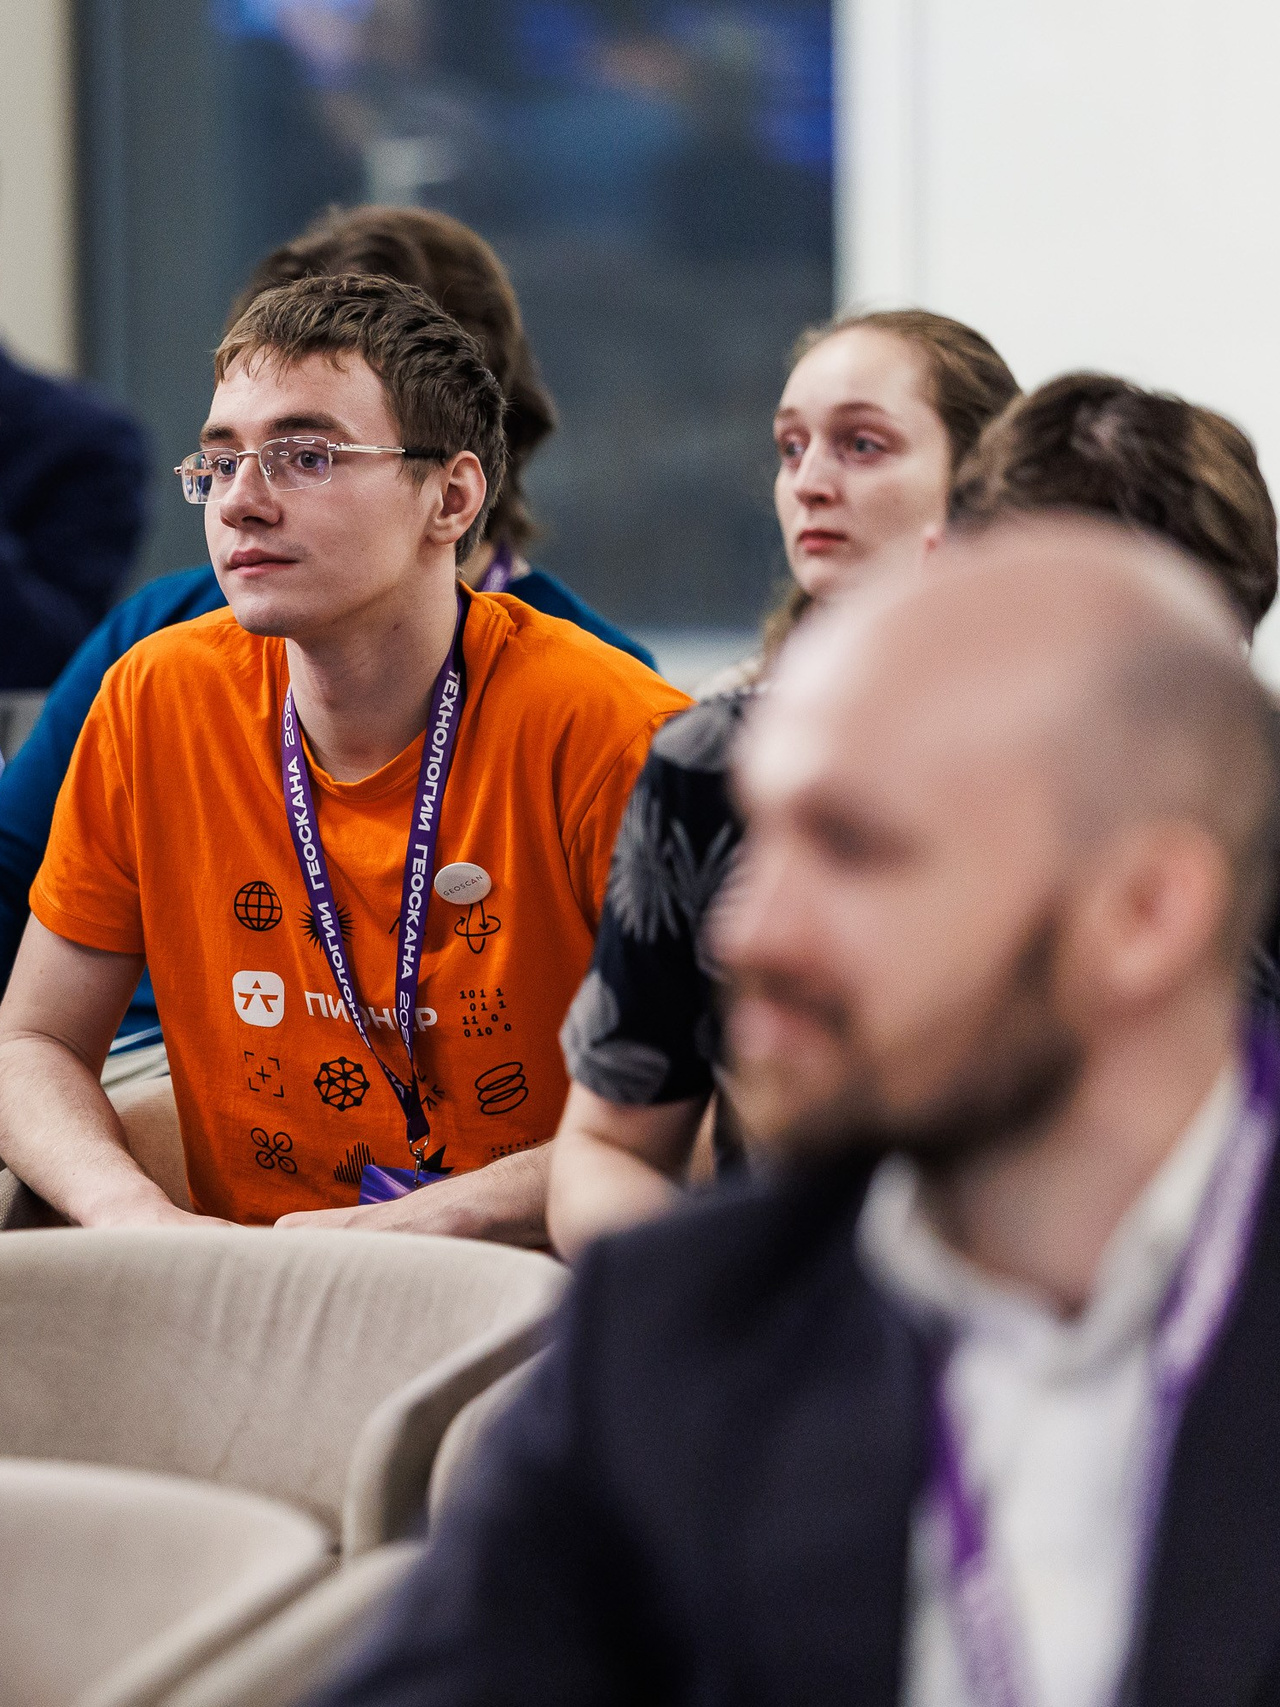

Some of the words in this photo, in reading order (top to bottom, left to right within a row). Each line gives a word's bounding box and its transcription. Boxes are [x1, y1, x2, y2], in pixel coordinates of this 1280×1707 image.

[284, 682, 296, 748] 202
[417, 670, 461, 833] ТЕХНОЛОГИИ
[287, 755, 325, 891] ГЕОСКАНА
[443, 874, 483, 897] GEOSCAN
[316, 901, 372, 1049] ХНОЛОГИИ
[400, 843, 429, 981] ГЕОСКАНА
[304, 990, 438, 1032] ПИНР
